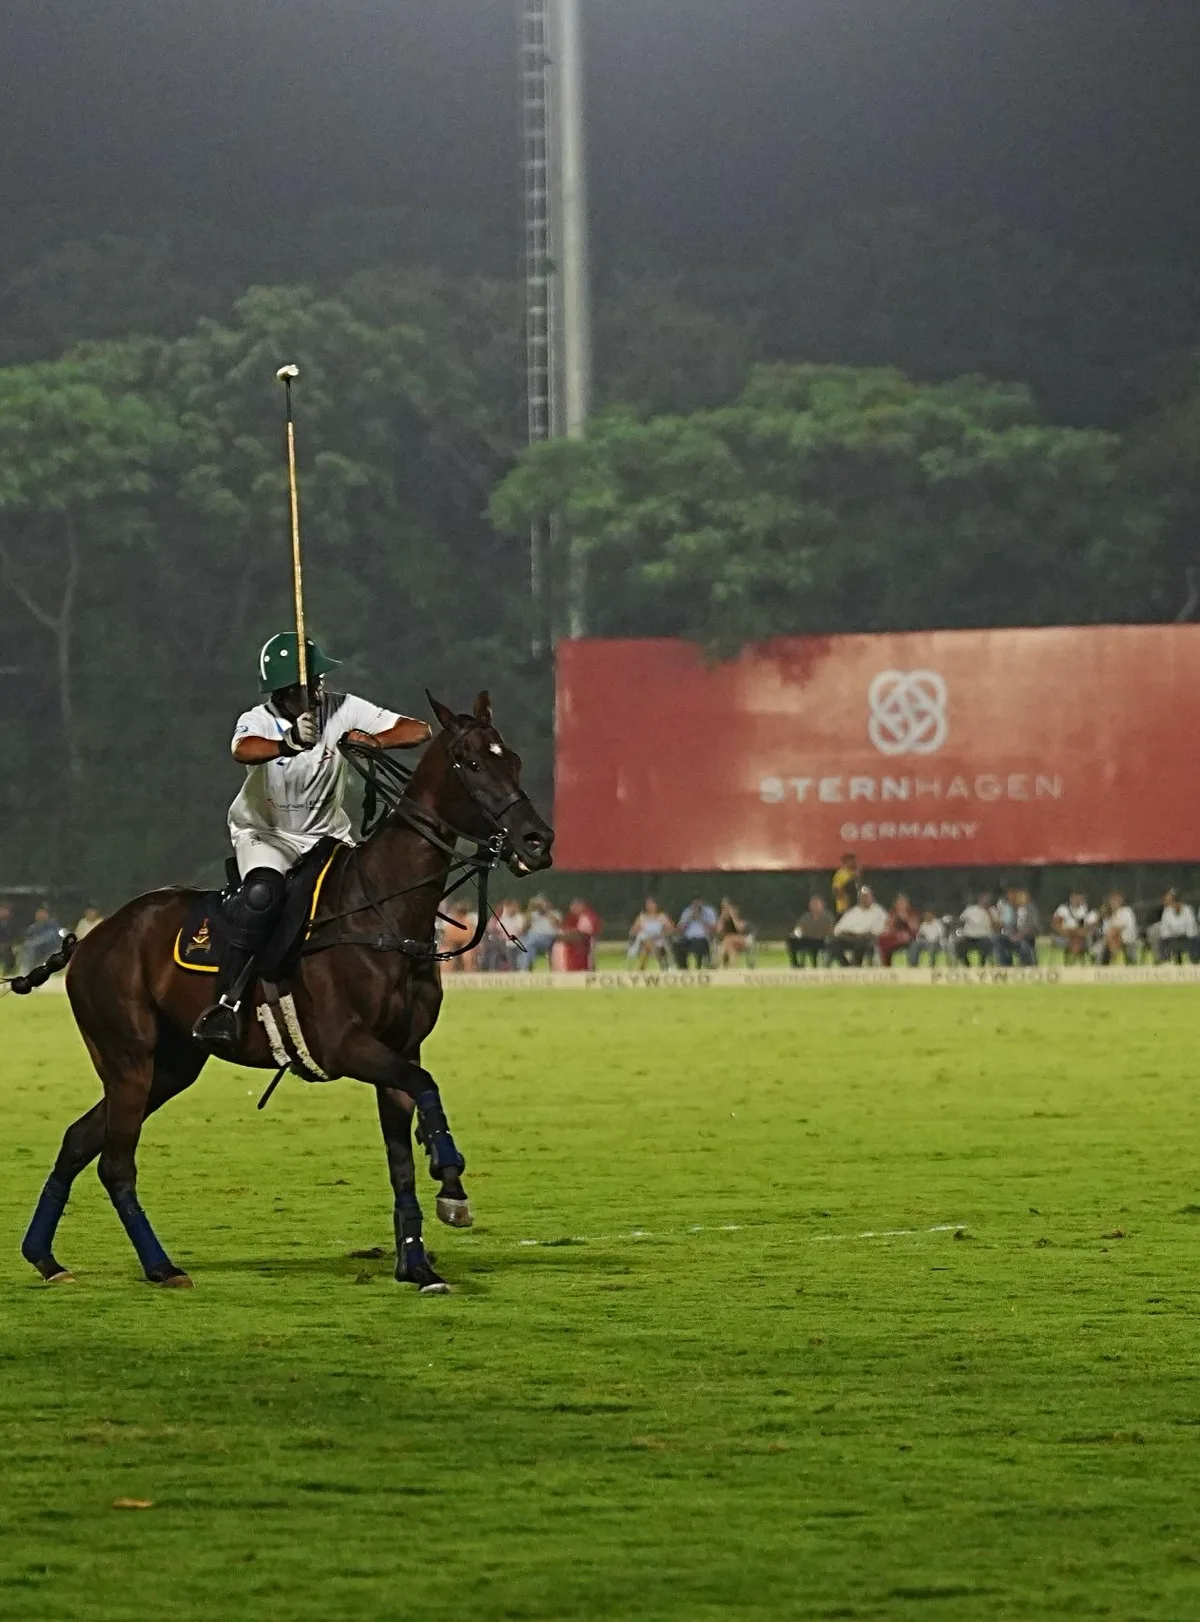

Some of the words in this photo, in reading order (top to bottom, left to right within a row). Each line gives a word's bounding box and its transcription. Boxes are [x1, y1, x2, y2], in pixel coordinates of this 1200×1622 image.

[759, 773, 1064, 803] STERNHAGEN
[840, 821, 978, 842] GERMANY
[585, 970, 711, 988] POLYWOOD
[931, 970, 1061, 985] POLYWOOD
